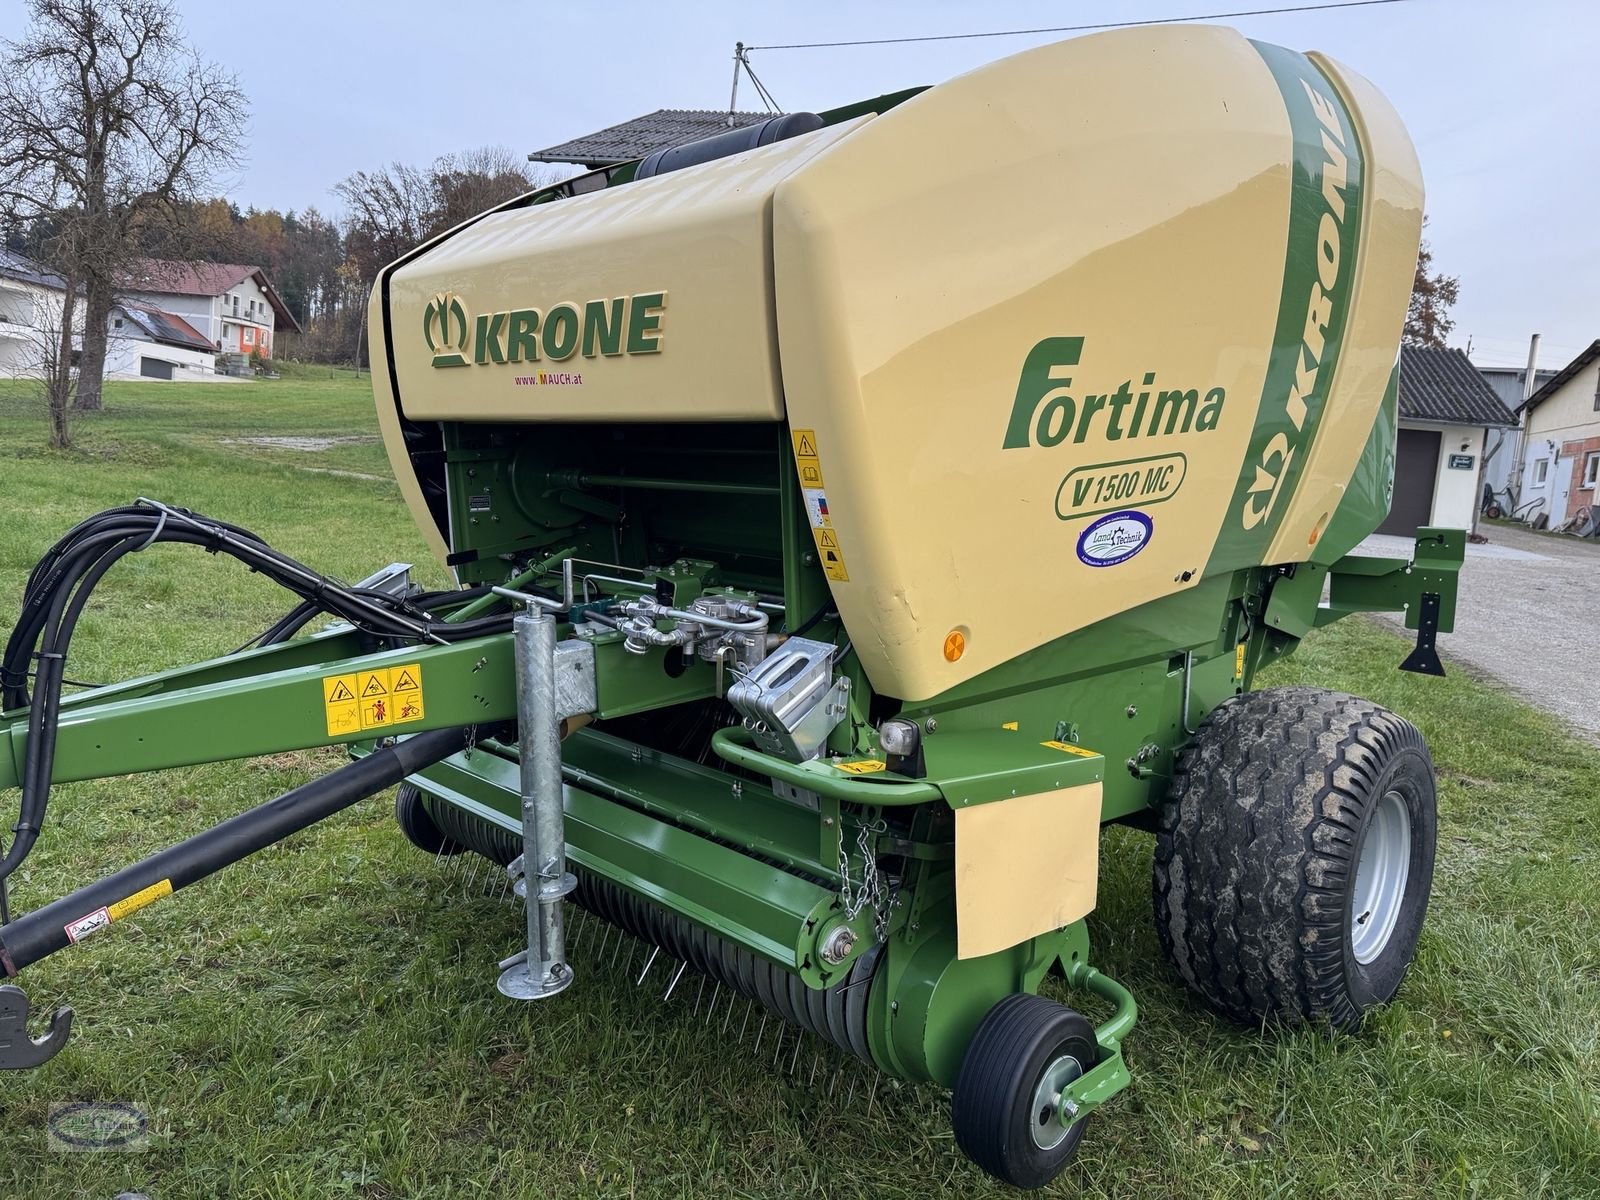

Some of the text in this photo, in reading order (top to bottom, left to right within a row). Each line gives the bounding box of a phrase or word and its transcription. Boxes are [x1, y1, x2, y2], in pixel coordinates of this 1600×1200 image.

[1286, 77, 1348, 432] KRONE
[474, 292, 666, 364] KRONE
[1002, 336, 1225, 449] Fortima
[1071, 464, 1174, 507] V 1500 MC
[1093, 530, 1112, 543] Land
[1116, 531, 1142, 545] Technik
